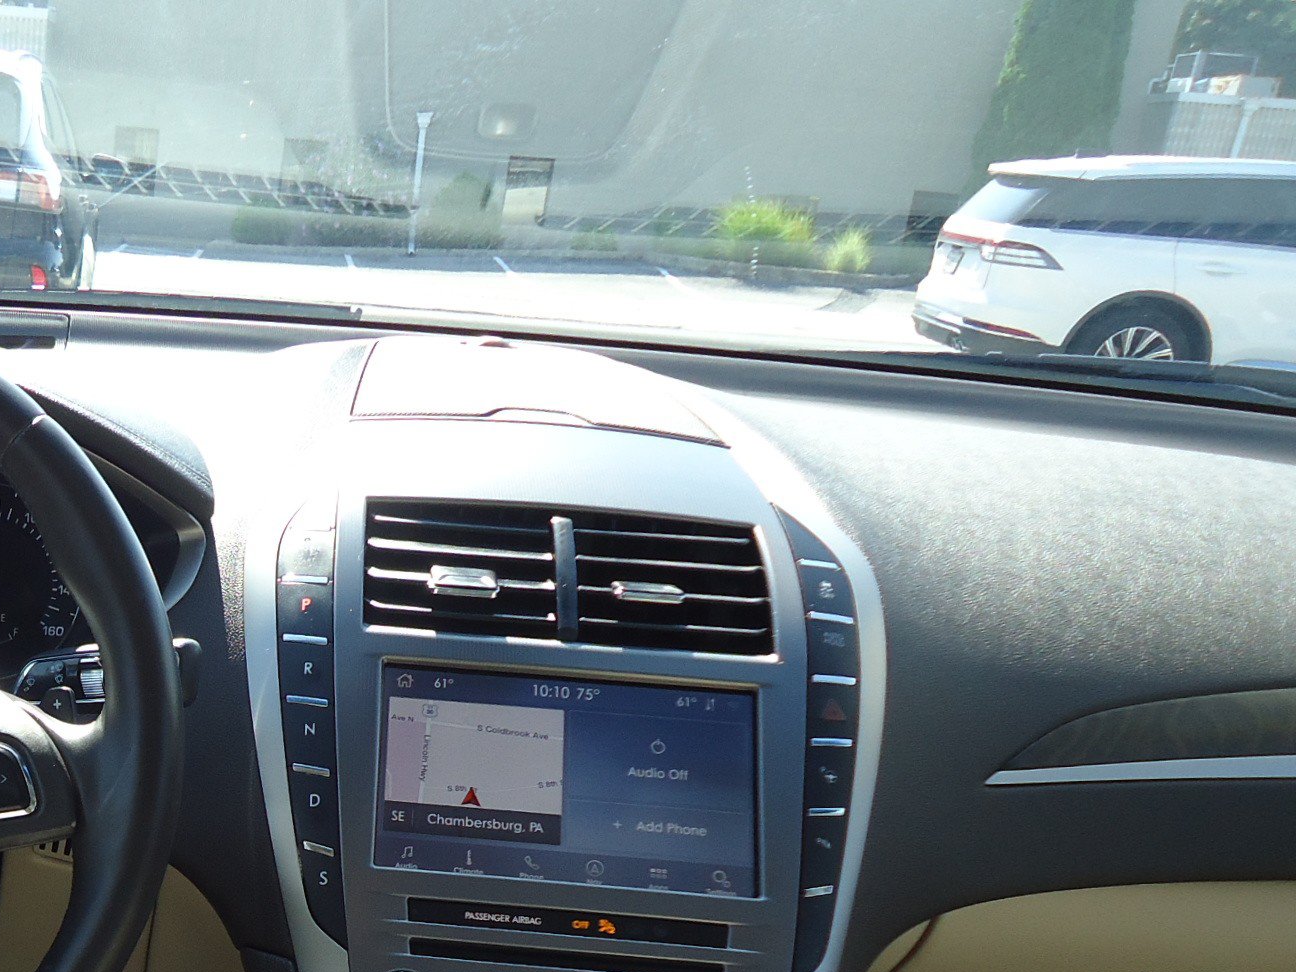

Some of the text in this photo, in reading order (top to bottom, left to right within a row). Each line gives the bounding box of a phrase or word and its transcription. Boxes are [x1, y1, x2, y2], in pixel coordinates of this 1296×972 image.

[300, 598, 312, 611] P
[43, 625, 64, 637] 160
[304, 661, 314, 675] R
[434, 678, 454, 689] 61°
[533, 684, 601, 701] 10:10 75°
[391, 713, 406, 722] Ave
[304, 723, 316, 736] N
[485, 725, 530, 738] Coldbrook
[533, 732, 549, 741] Ave
[419, 735, 432, 782] Lincoln Hwy
[627, 767, 689, 781] Audio Off
[310, 794, 320, 808] D
[391, 810, 405, 822] SE
[428, 813, 544, 834] Chambersburg, PA
[636, 821, 708, 837] Add Phone
[319, 871, 328, 885] S
[464, 911, 511, 923] PASSENGER
[512, 914, 542, 926] AIRBAG
